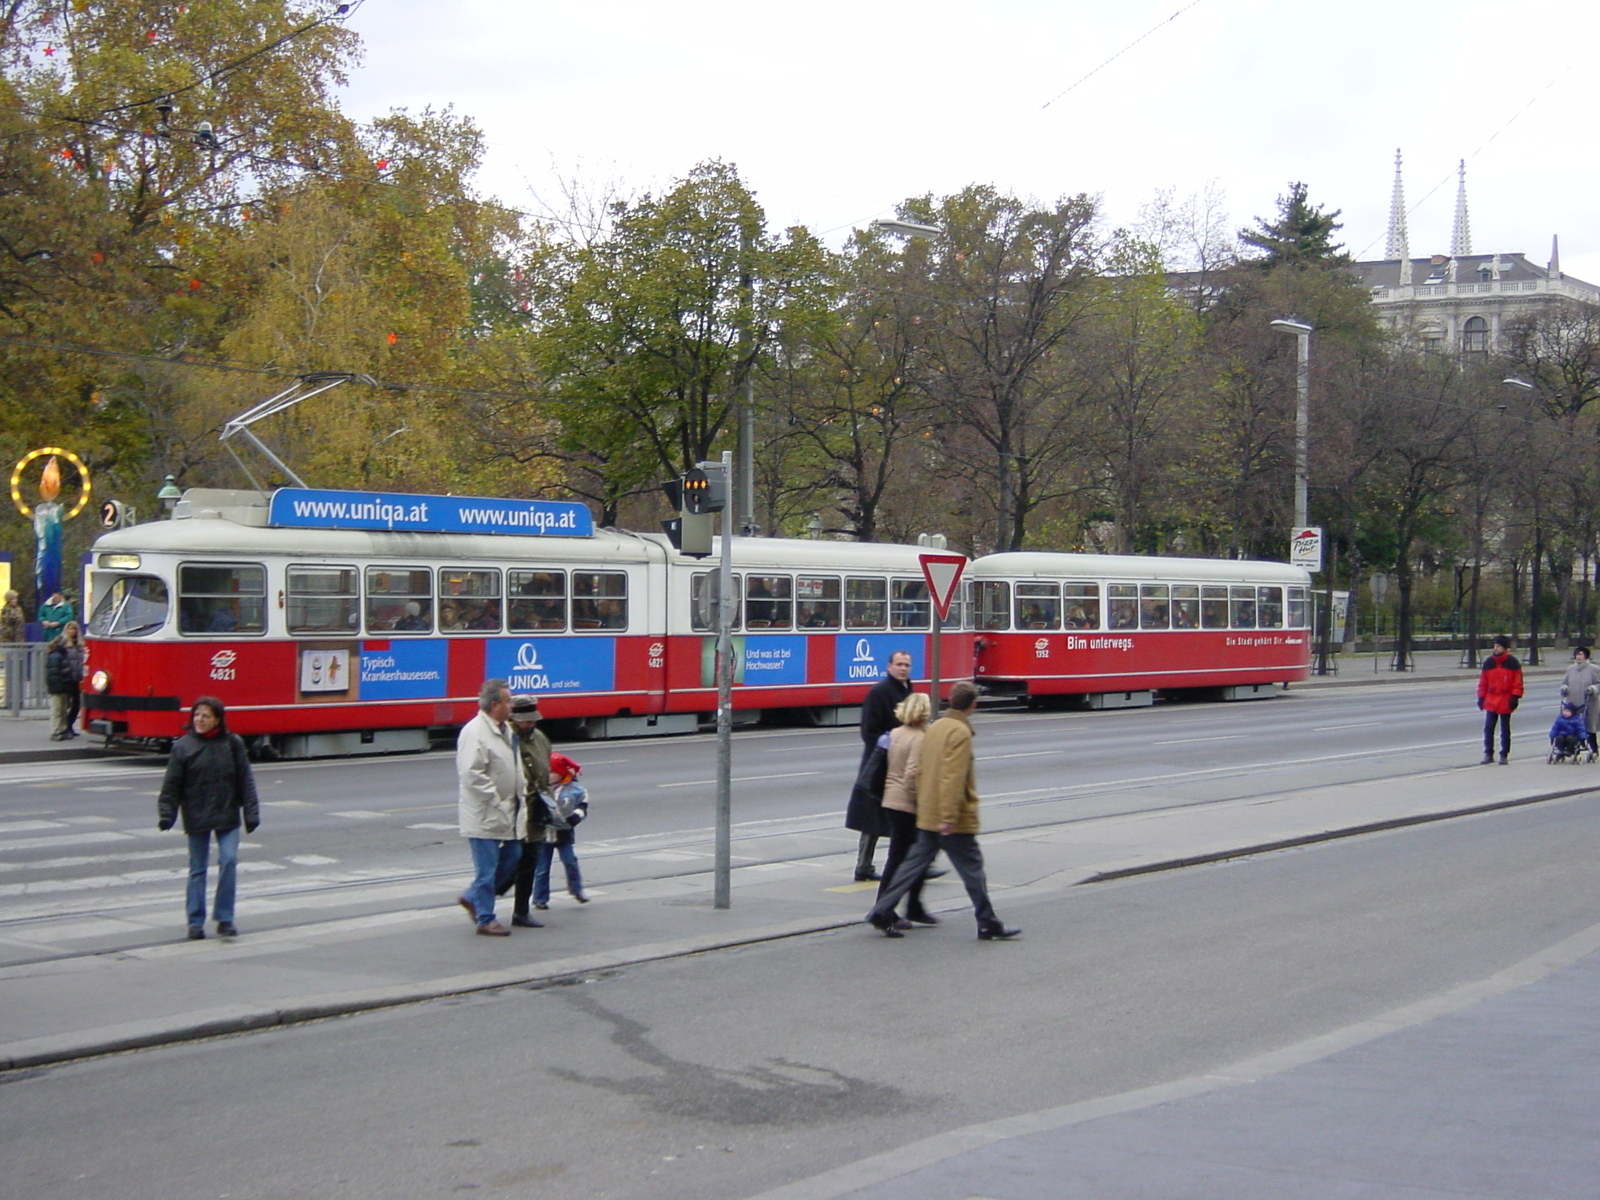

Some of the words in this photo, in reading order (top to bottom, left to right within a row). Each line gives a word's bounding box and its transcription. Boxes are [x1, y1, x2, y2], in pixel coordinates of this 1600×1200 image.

[103, 504, 115, 526] 2
[293, 498, 428, 529] www.uniqa.at
[459, 506, 576, 534] www.uniqa.at
[1298, 545, 1316, 554] Hut
[1067, 636, 1087, 650] Bim
[1090, 636, 1135, 651] unterwegs.
[746, 649, 759, 658] Und
[760, 651, 772, 659] was
[773, 649, 782, 659] ist
[782, 648, 791, 658] bei
[1035, 650, 1049, 658] 1352
[362, 656, 395, 671] Typisch
[746, 659, 784, 670] Hochwasser?
[362, 669, 440, 682] Krankenhausessen.
[849, 665, 879, 679] UNIQA
[508, 674, 550, 690] UNIQA
